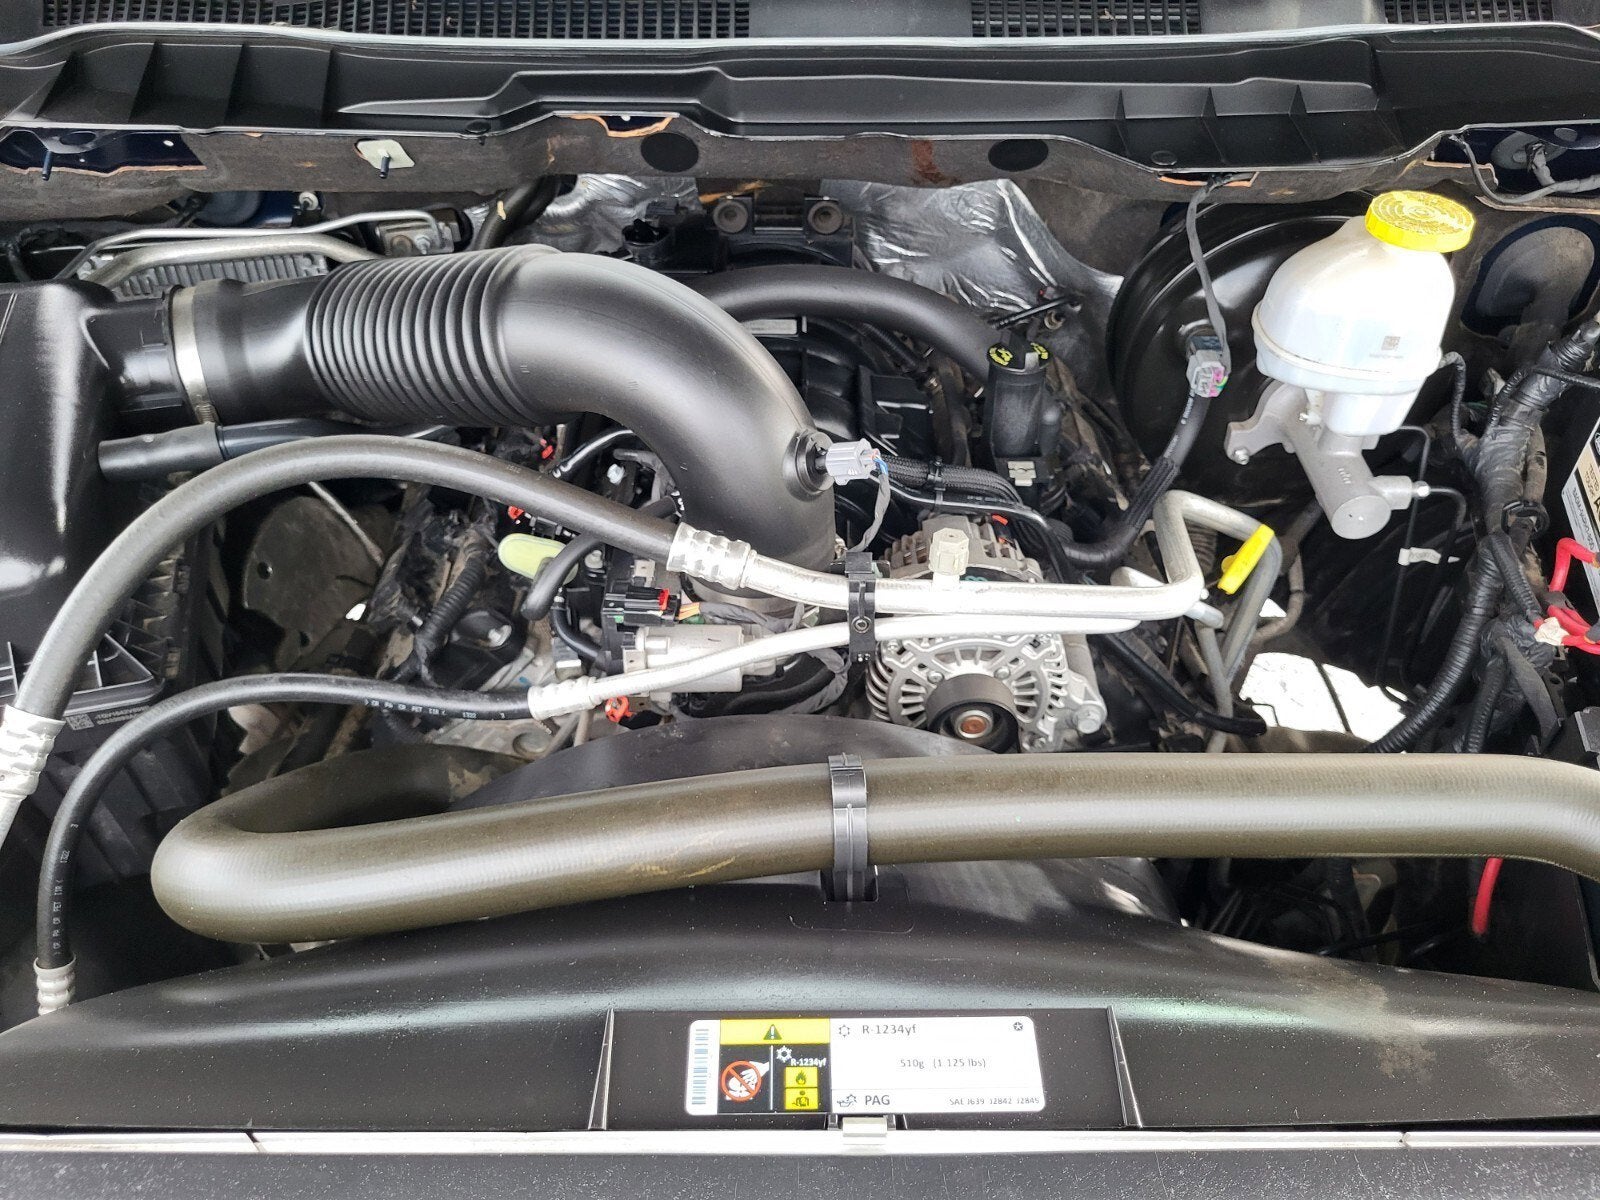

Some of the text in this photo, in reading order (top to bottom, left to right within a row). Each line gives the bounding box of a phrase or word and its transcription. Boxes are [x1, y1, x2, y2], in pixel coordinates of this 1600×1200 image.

[862, 1023, 917, 1037] R-1234yf
[790, 1057, 827, 1068] R-1234yf
[900, 1059, 925, 1069] 510g
[968, 1058, 986, 1068] lbs)
[865, 1094, 891, 1106] PAG
